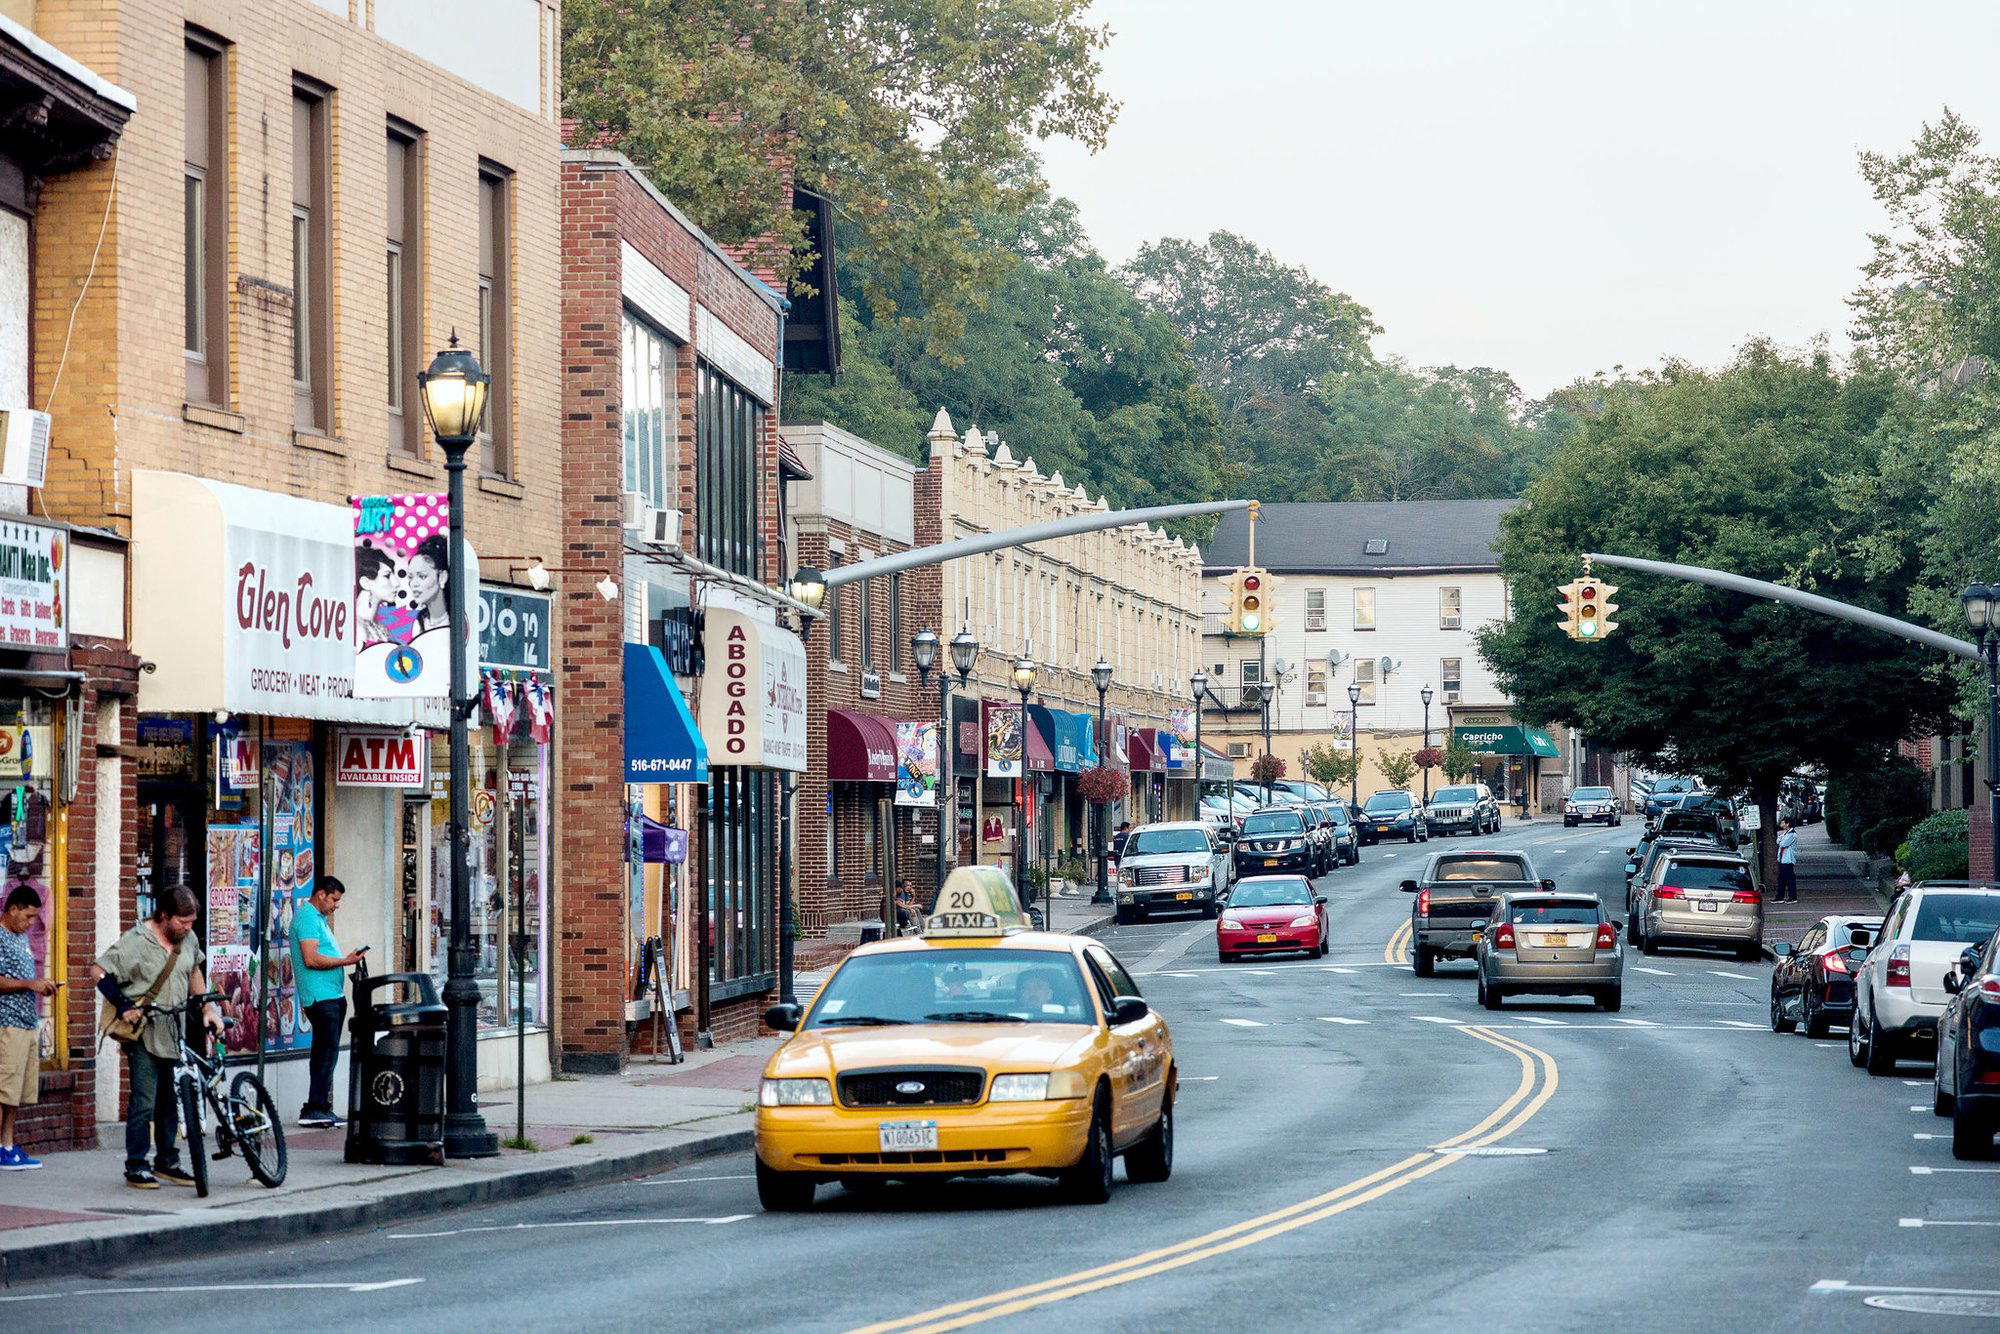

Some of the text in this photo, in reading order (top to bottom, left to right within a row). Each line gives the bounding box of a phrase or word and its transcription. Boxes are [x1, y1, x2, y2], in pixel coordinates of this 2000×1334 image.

[356, 506, 393, 534] ART
[237, 561, 346, 649] Glen Cove
[251, 668, 292, 694] GROCERY
[299, 672, 321, 696] MEAT
[726, 625, 747, 754] ABOGADO
[1462, 733, 1504, 742] Capricho
[342, 737, 416, 770] ATM
[631, 758, 692, 772] 516-671-0447
[340, 772, 419, 784] AVAILABLE INSIDE
[950, 891, 975, 909] 20
[945, 913, 981, 928] TAXI
